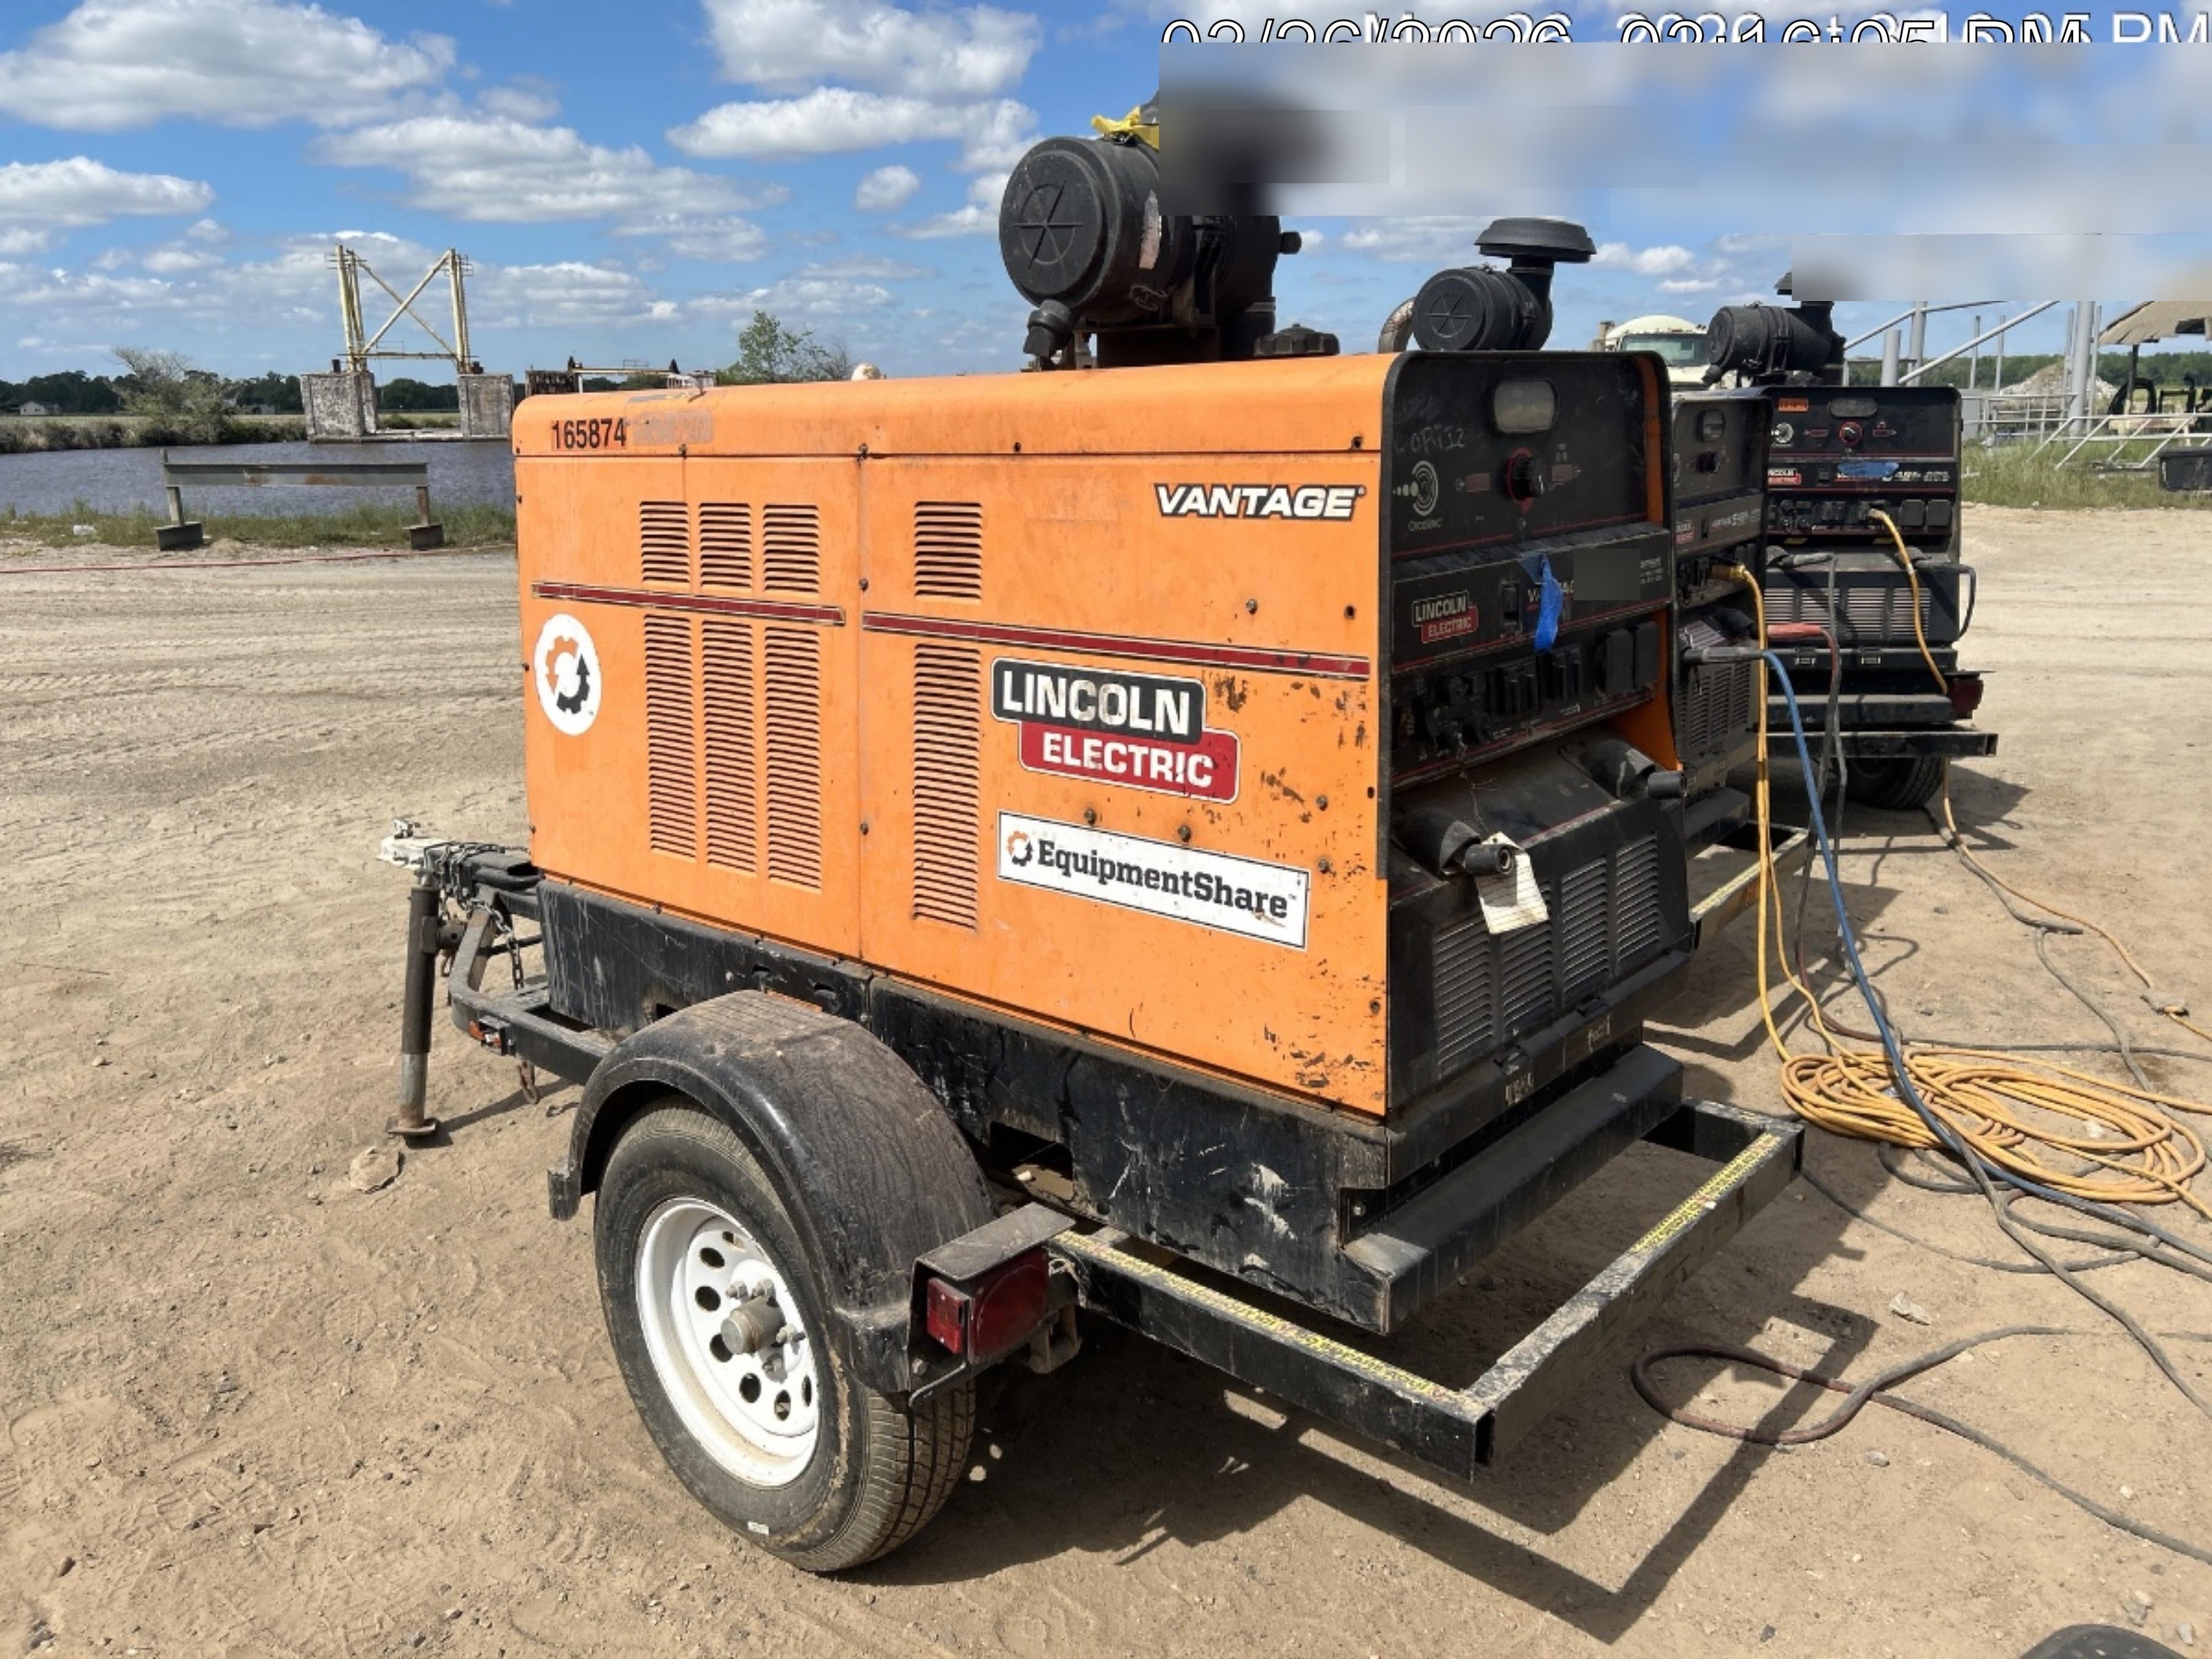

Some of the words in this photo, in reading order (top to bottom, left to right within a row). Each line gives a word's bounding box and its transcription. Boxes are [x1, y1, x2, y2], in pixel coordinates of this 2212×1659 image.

[552, 417, 626, 450] 165874
[1156, 485, 1357, 517] VANTAGE
[1415, 595, 1466, 622] LINCOLN
[1428, 616, 1472, 637] ELECTRIC
[1002, 669, 1190, 736] LINCOLN
[1043, 731, 1214, 788] ELECTRIC
[1037, 838, 1288, 919] EquipmentShare
